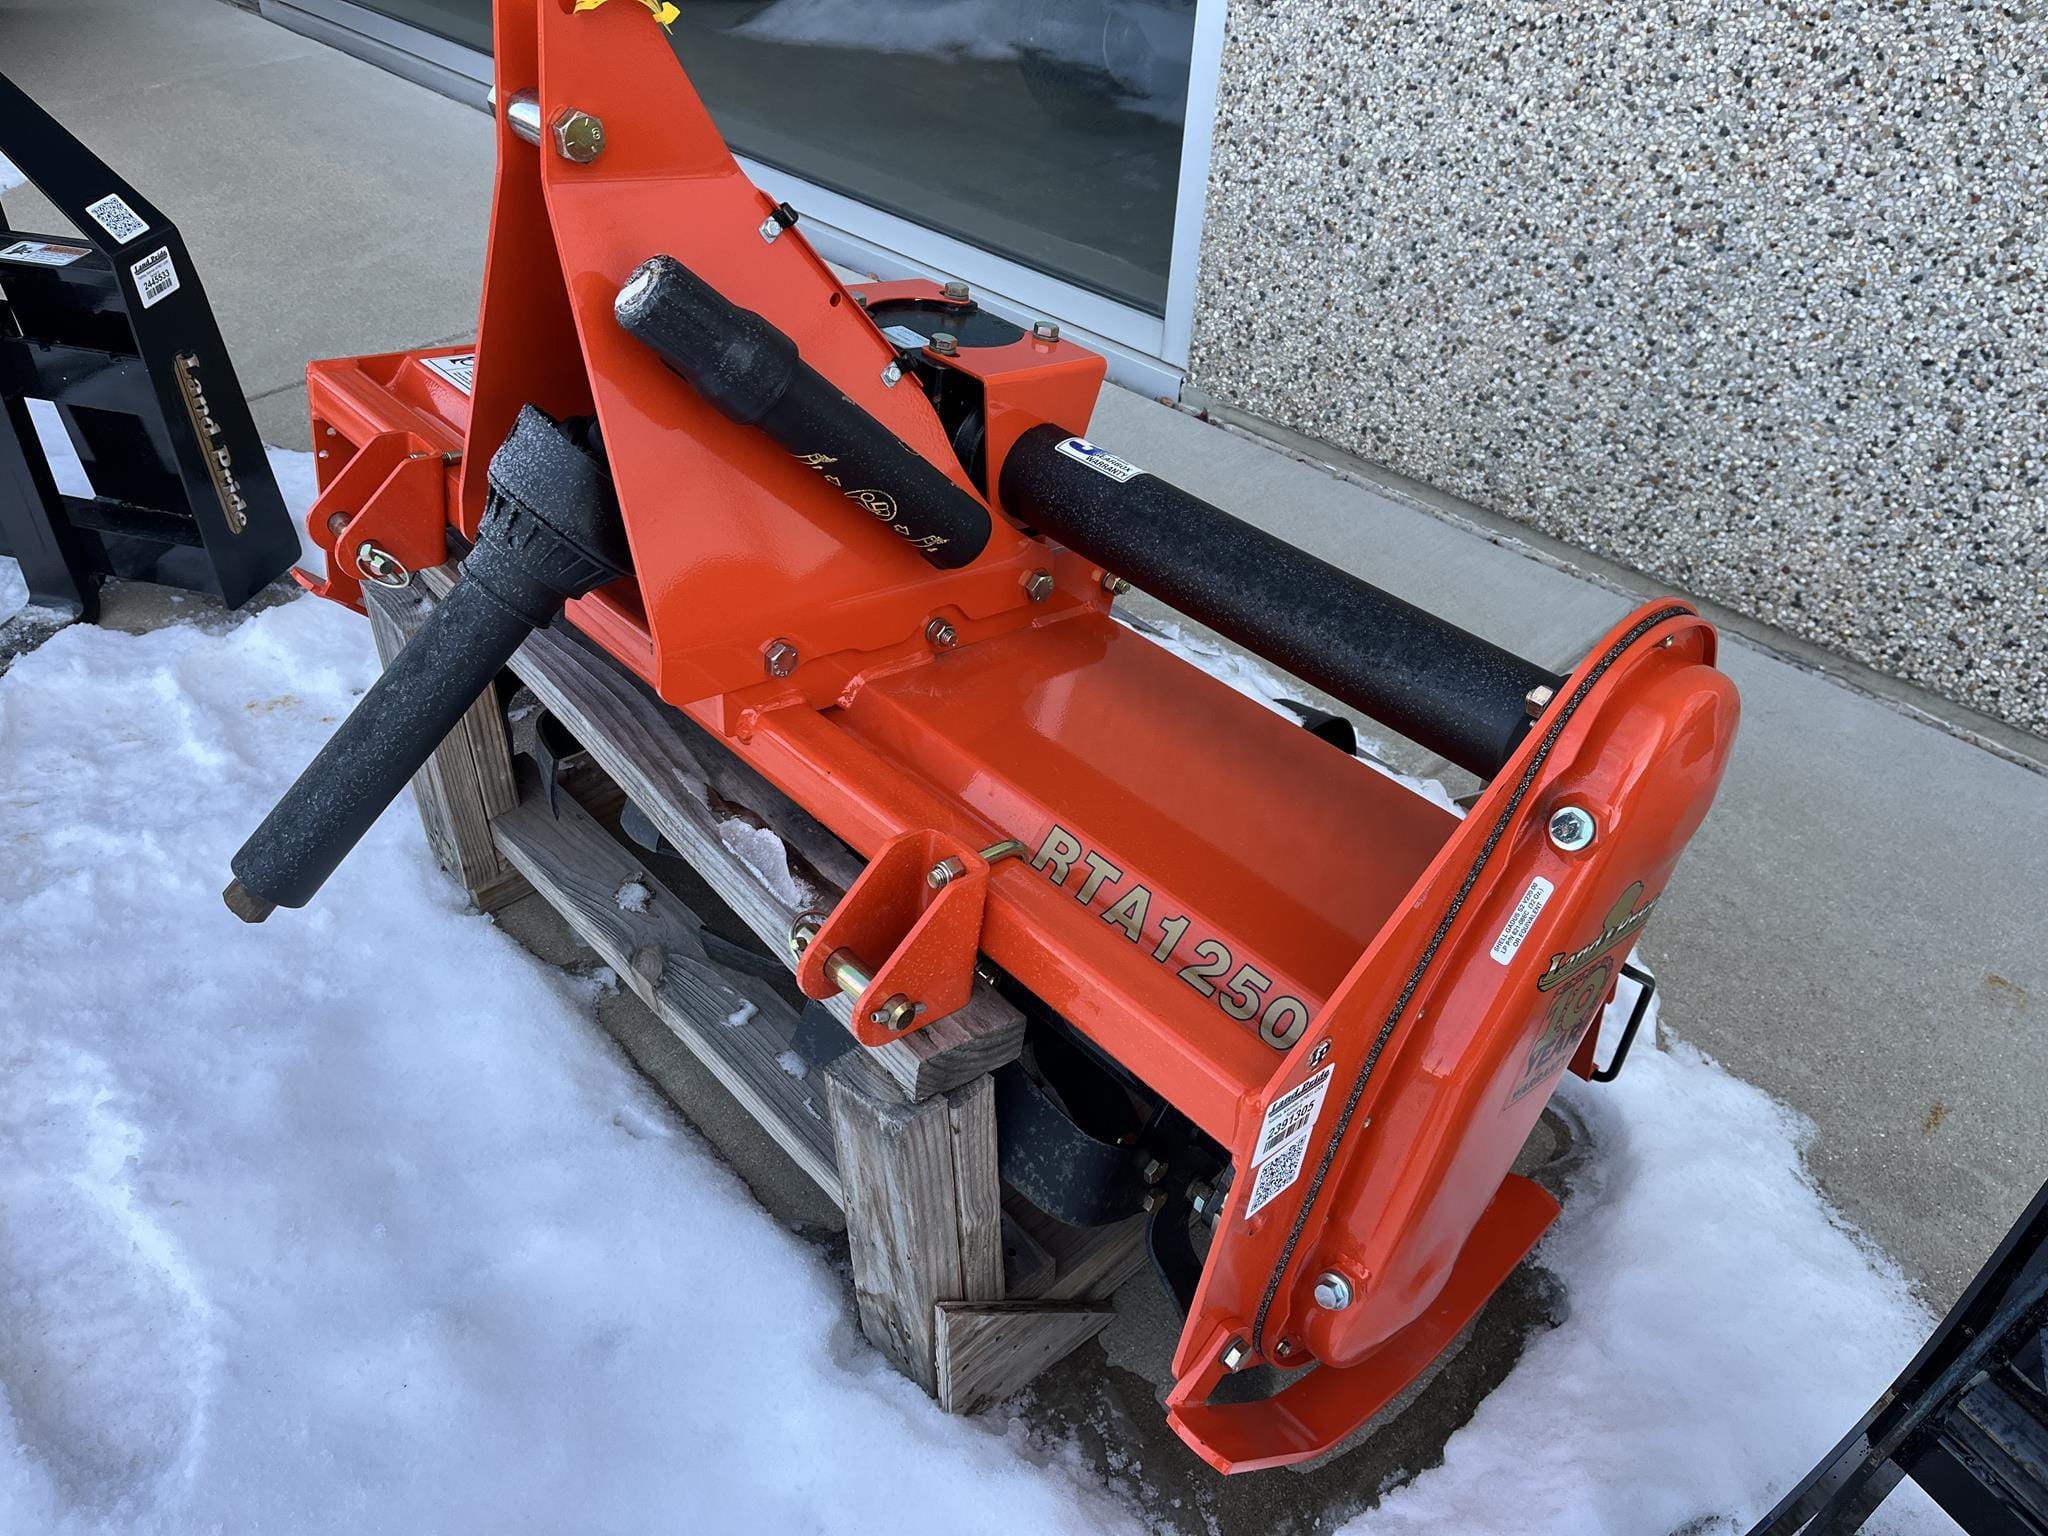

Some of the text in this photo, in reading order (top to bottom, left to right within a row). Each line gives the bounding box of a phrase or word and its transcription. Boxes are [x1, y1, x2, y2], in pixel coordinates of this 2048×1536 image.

[143, 269, 170, 291] 2445533
[176, 352, 248, 531] Land Pride
[1086, 455, 1129, 479] WARRANTY
[1030, 824, 1310, 1051] RTA1250
[1493, 934, 1508, 952] SHELL
[1505, 912, 1520, 933] GADUS
[1519, 902, 1542, 938] EQUIVALENT
[1266, 1099, 1316, 1141] 2391305
[1269, 1087, 1301, 1115] Land
